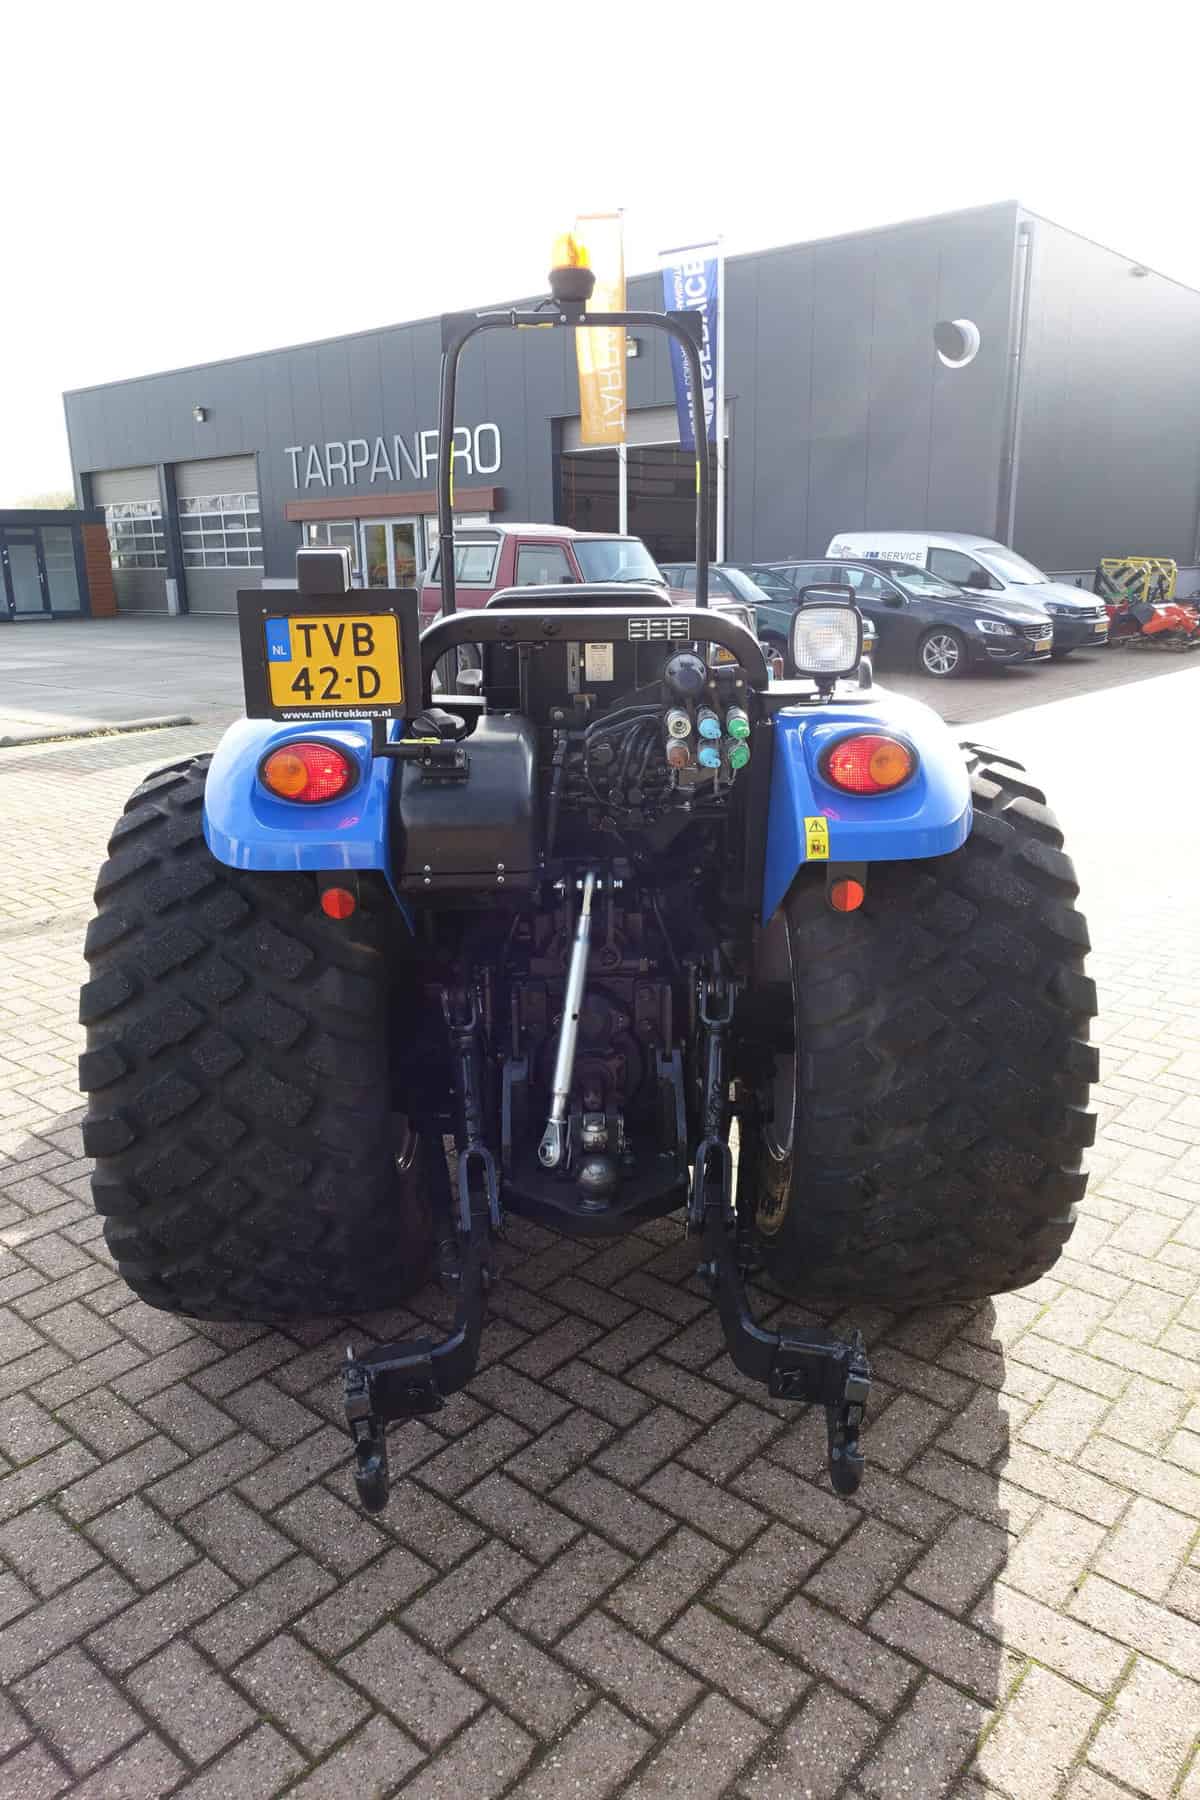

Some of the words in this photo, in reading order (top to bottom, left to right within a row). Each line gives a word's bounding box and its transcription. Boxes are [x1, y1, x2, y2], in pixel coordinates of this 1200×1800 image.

[284, 423, 502, 489] TARPANPRO
[880, 551, 922, 560] SERVICE
[272, 645, 288, 656] NL
[295, 622, 376, 658] TVB
[290, 665, 382, 701] 42-D
[281, 708, 392, 720] www.minitrekkers.nl
